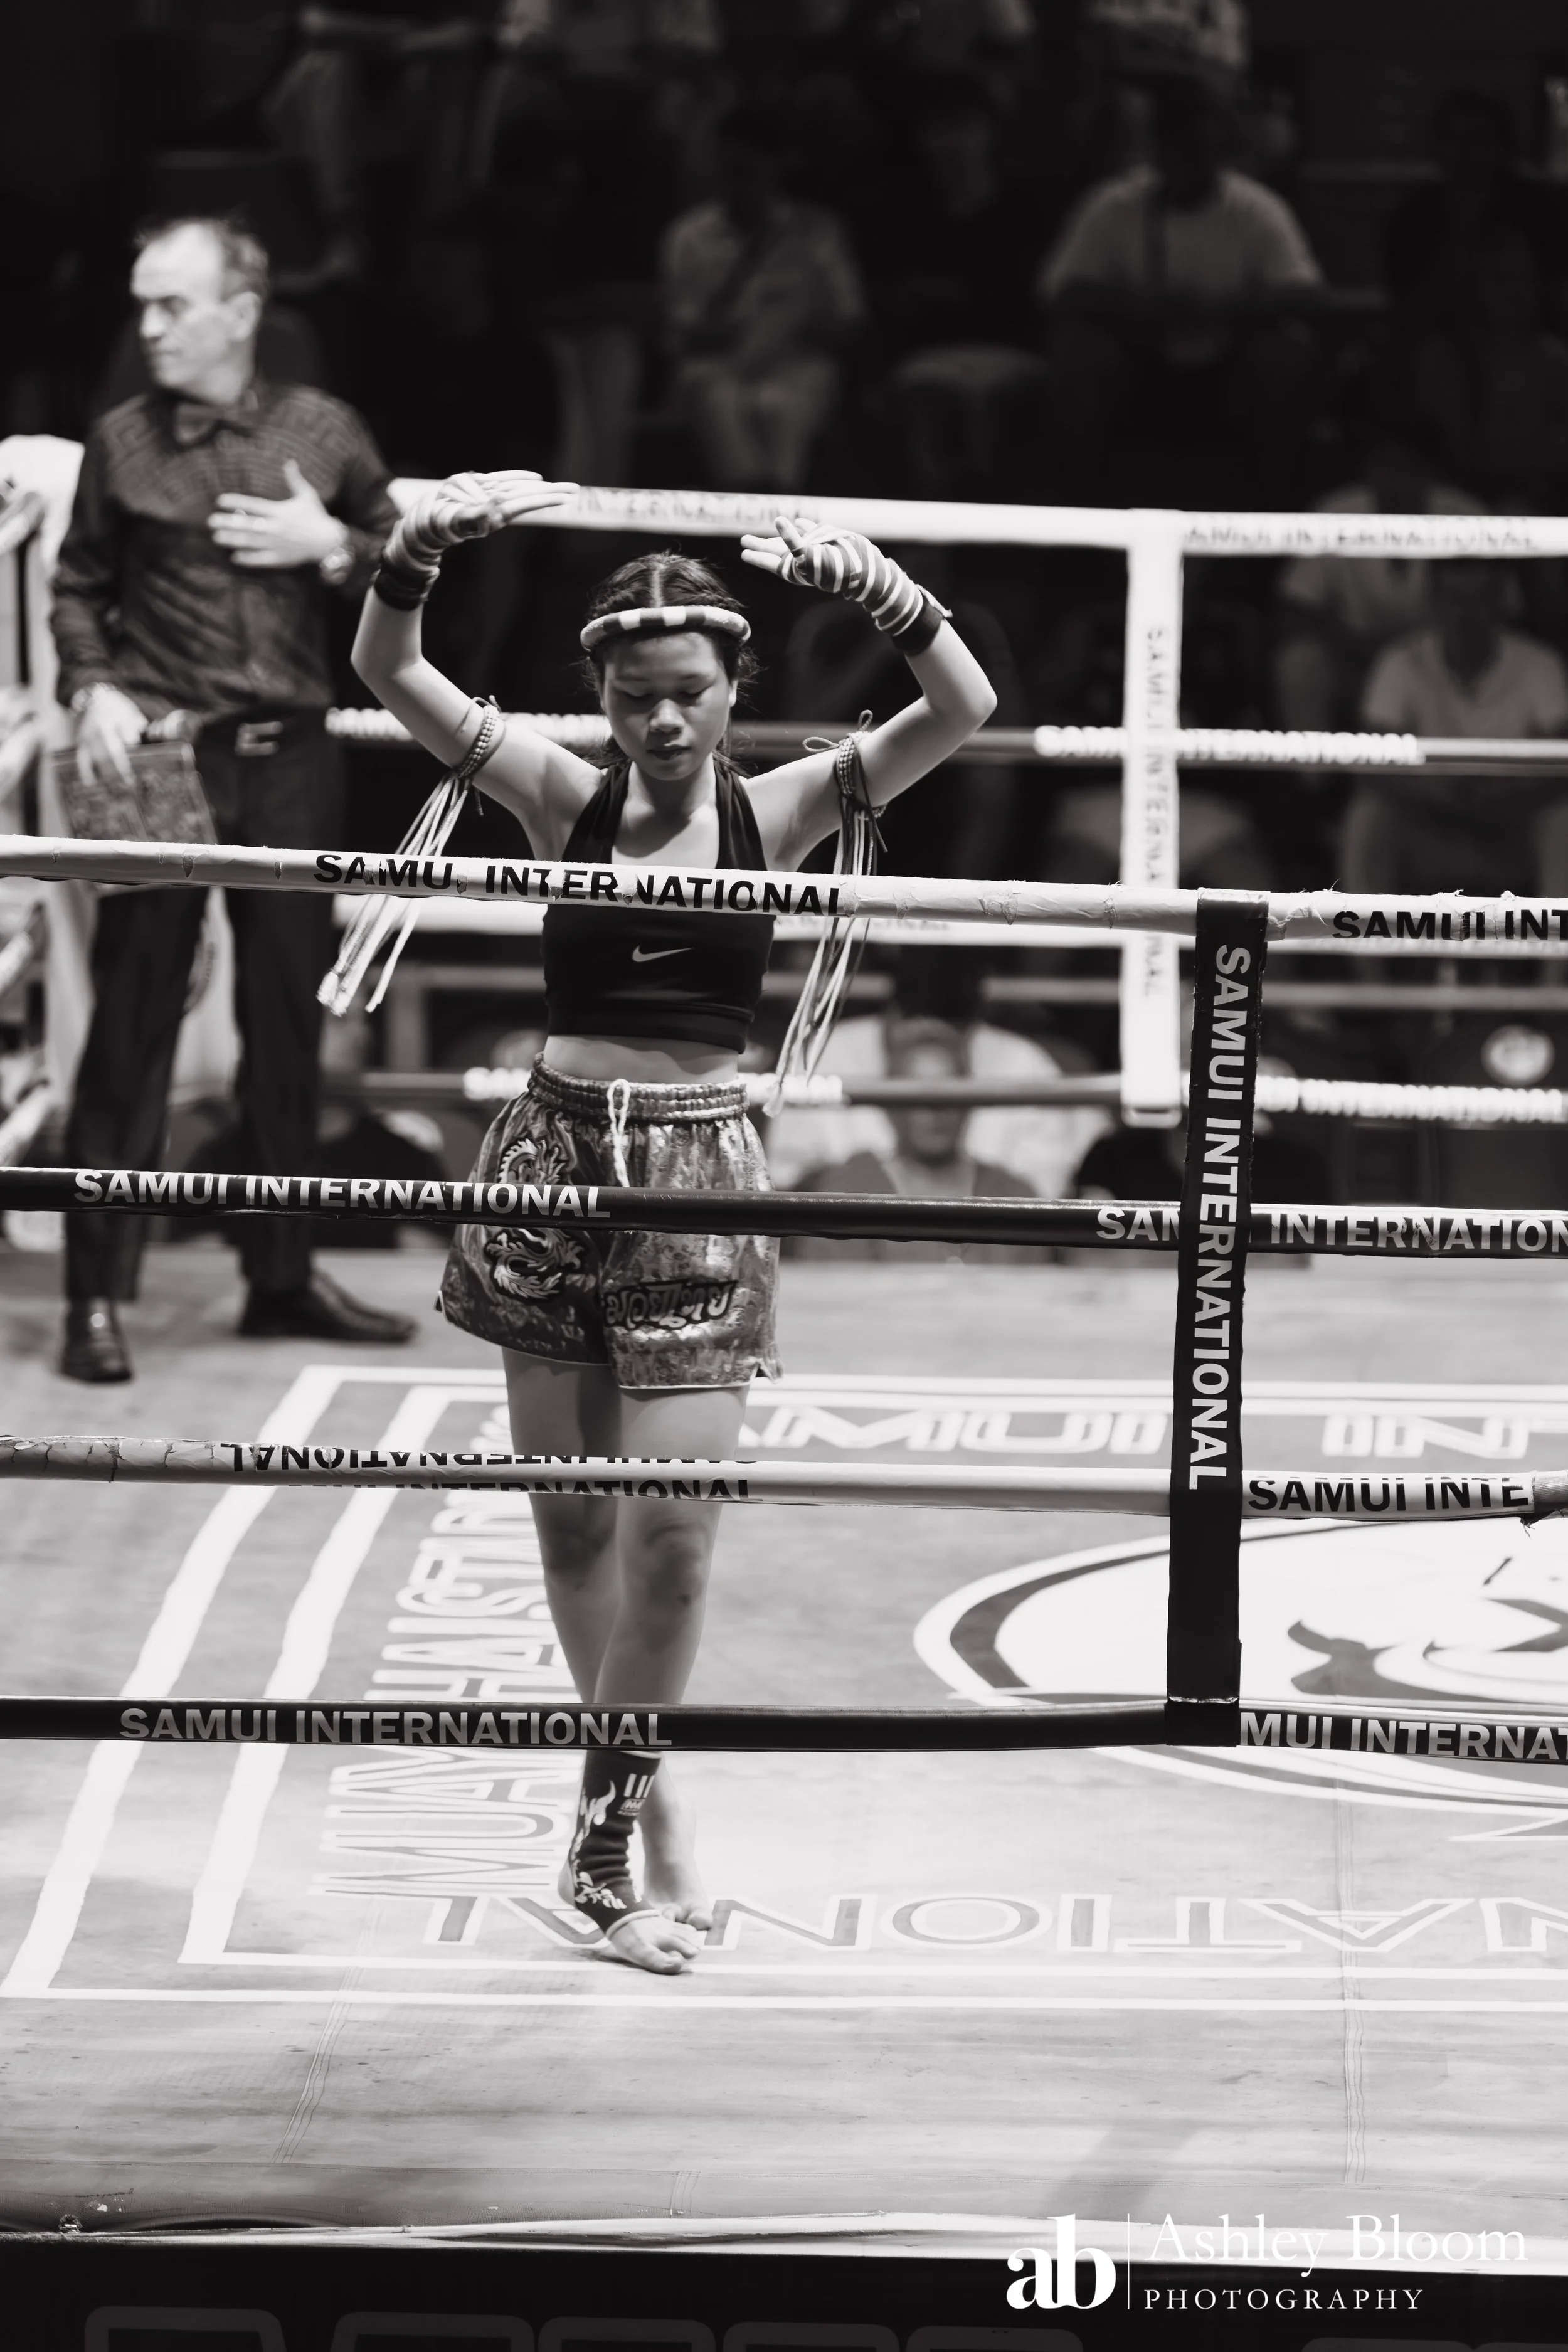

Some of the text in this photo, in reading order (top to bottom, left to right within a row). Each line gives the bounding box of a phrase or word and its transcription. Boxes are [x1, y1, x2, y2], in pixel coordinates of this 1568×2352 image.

[314, 854, 839, 915] SAMU INTERNATIONAL
[1145, 746, 1169, 997] INTERNANAL
[1332, 911, 1485, 941] SAMUI
[74, 1169, 610, 1218] SAMUI INTERNATIONAL
[1189, 944, 1251, 1490] SAMUI INTERNATIONAL
[739, 1406, 1568, 1459] MUI IN
[1248, 1476, 1529, 1512] SAMUI INTE
[363, 1617, 581, 1702] HAI
[120, 1708, 672, 1746] SAMUI INTERNATIONAL
[1239, 1712, 1332, 1749] MUI
